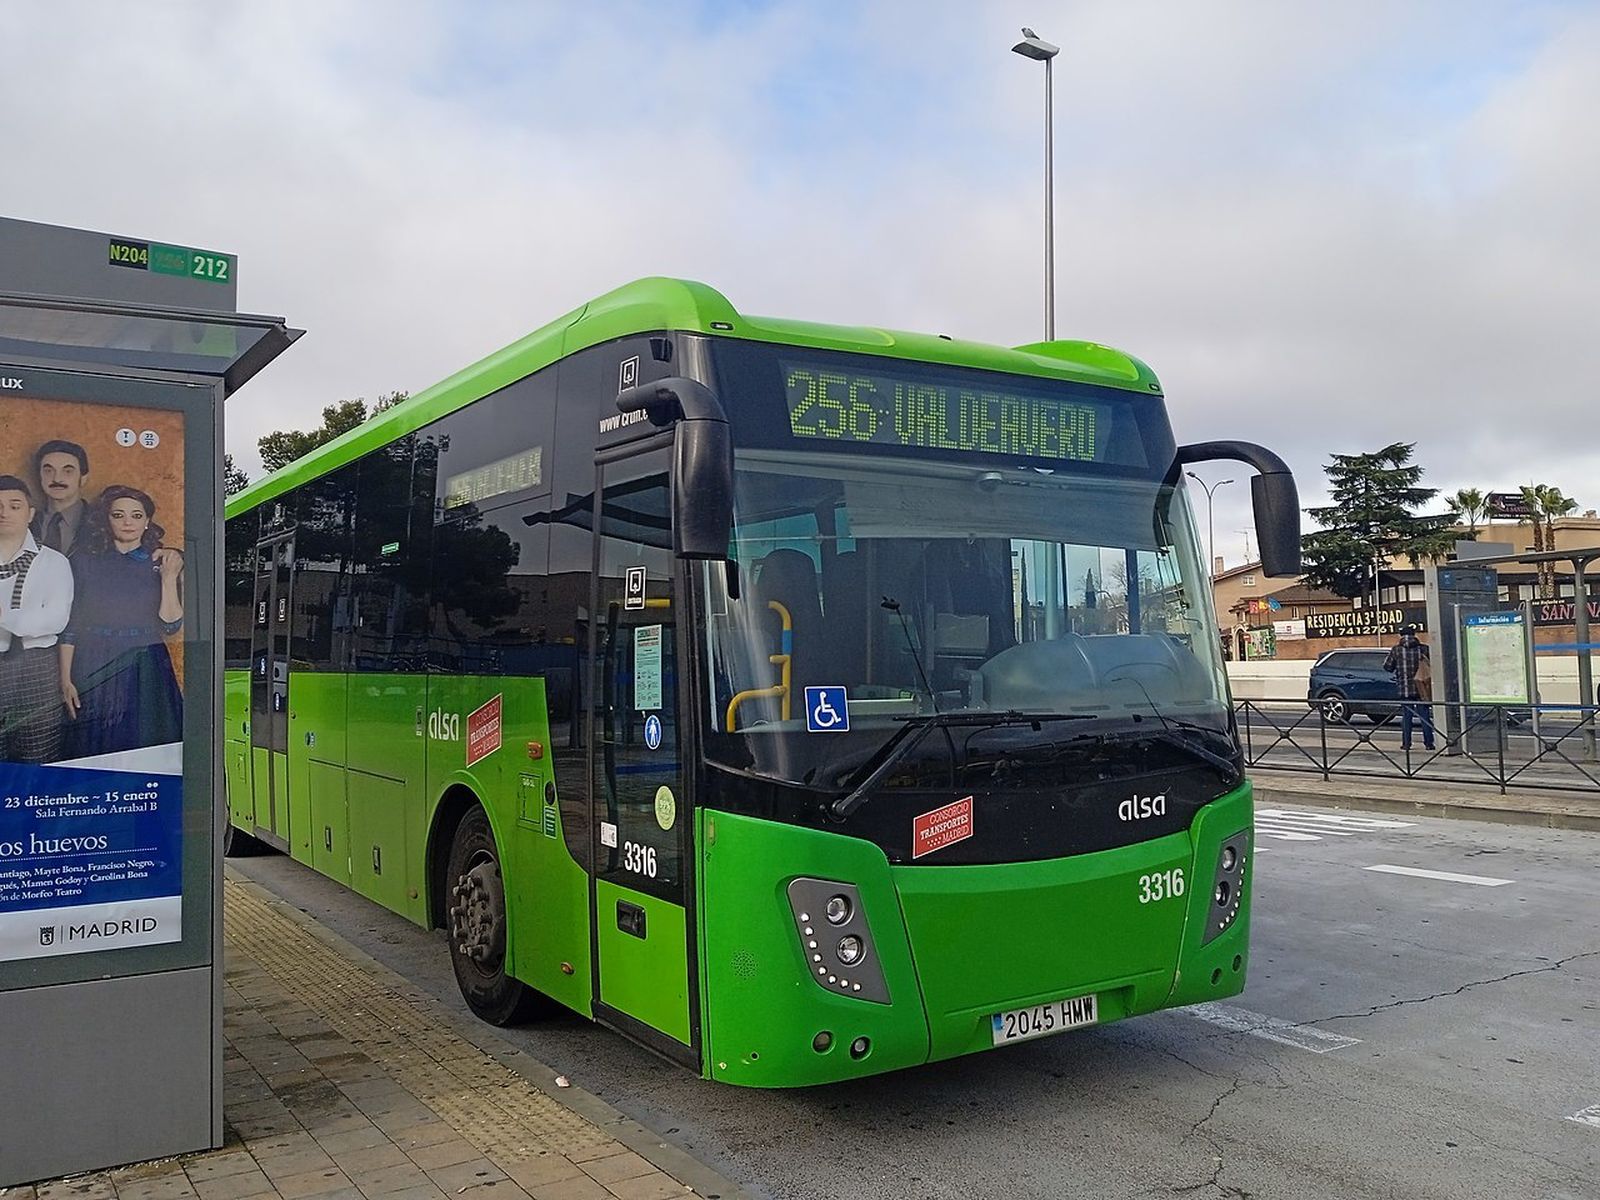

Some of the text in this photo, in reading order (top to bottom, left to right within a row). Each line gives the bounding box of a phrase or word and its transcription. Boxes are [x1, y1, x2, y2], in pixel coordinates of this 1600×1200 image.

[109, 244, 148, 265] N204
[193, 255, 229, 279] 212
[0, 377, 23, 390] ux
[787, 370, 1096, 461] 256 VALDEAVERO
[1307, 613, 1362, 628] RESIDENCIA
[1378, 609, 1403, 624] EDAD
[1320, 628, 1334, 636] 91
[1339, 625, 1394, 635] 7412761
[429, 707, 459, 741] alsa
[5, 797, 20, 808] 23
[25, 793, 89, 807] diciembre
[105, 791, 119, 802] 15
[124, 791, 158, 801] enero
[36, 802, 158, 818] Sala Fernando Arrabal B
[1118, 794, 1166, 821] alsa
[929, 802, 969, 825] CONSORCIO
[920, 814, 969, 840] TRANSPORTES
[942, 825, 969, 844] MADRID
[29, 833, 108, 855] huevos
[34, 868, 61, 878] Mayte
[88, 862, 126, 872] Francisco
[127, 860, 155, 869] Negro,
[624, 841, 657, 878] 3316
[21, 880, 54, 888] Mamen
[55, 876, 81, 885] Godoy
[90, 872, 126, 882] Carolina
[1139, 868, 1185, 904] 3316
[10, 892, 21, 901] de
[21, 890, 54, 900] Morfeo
[55, 888, 82, 896] Teatro
[69, 918, 157, 940] MADRID
[1005, 996, 1093, 1039] 2045 HMW
